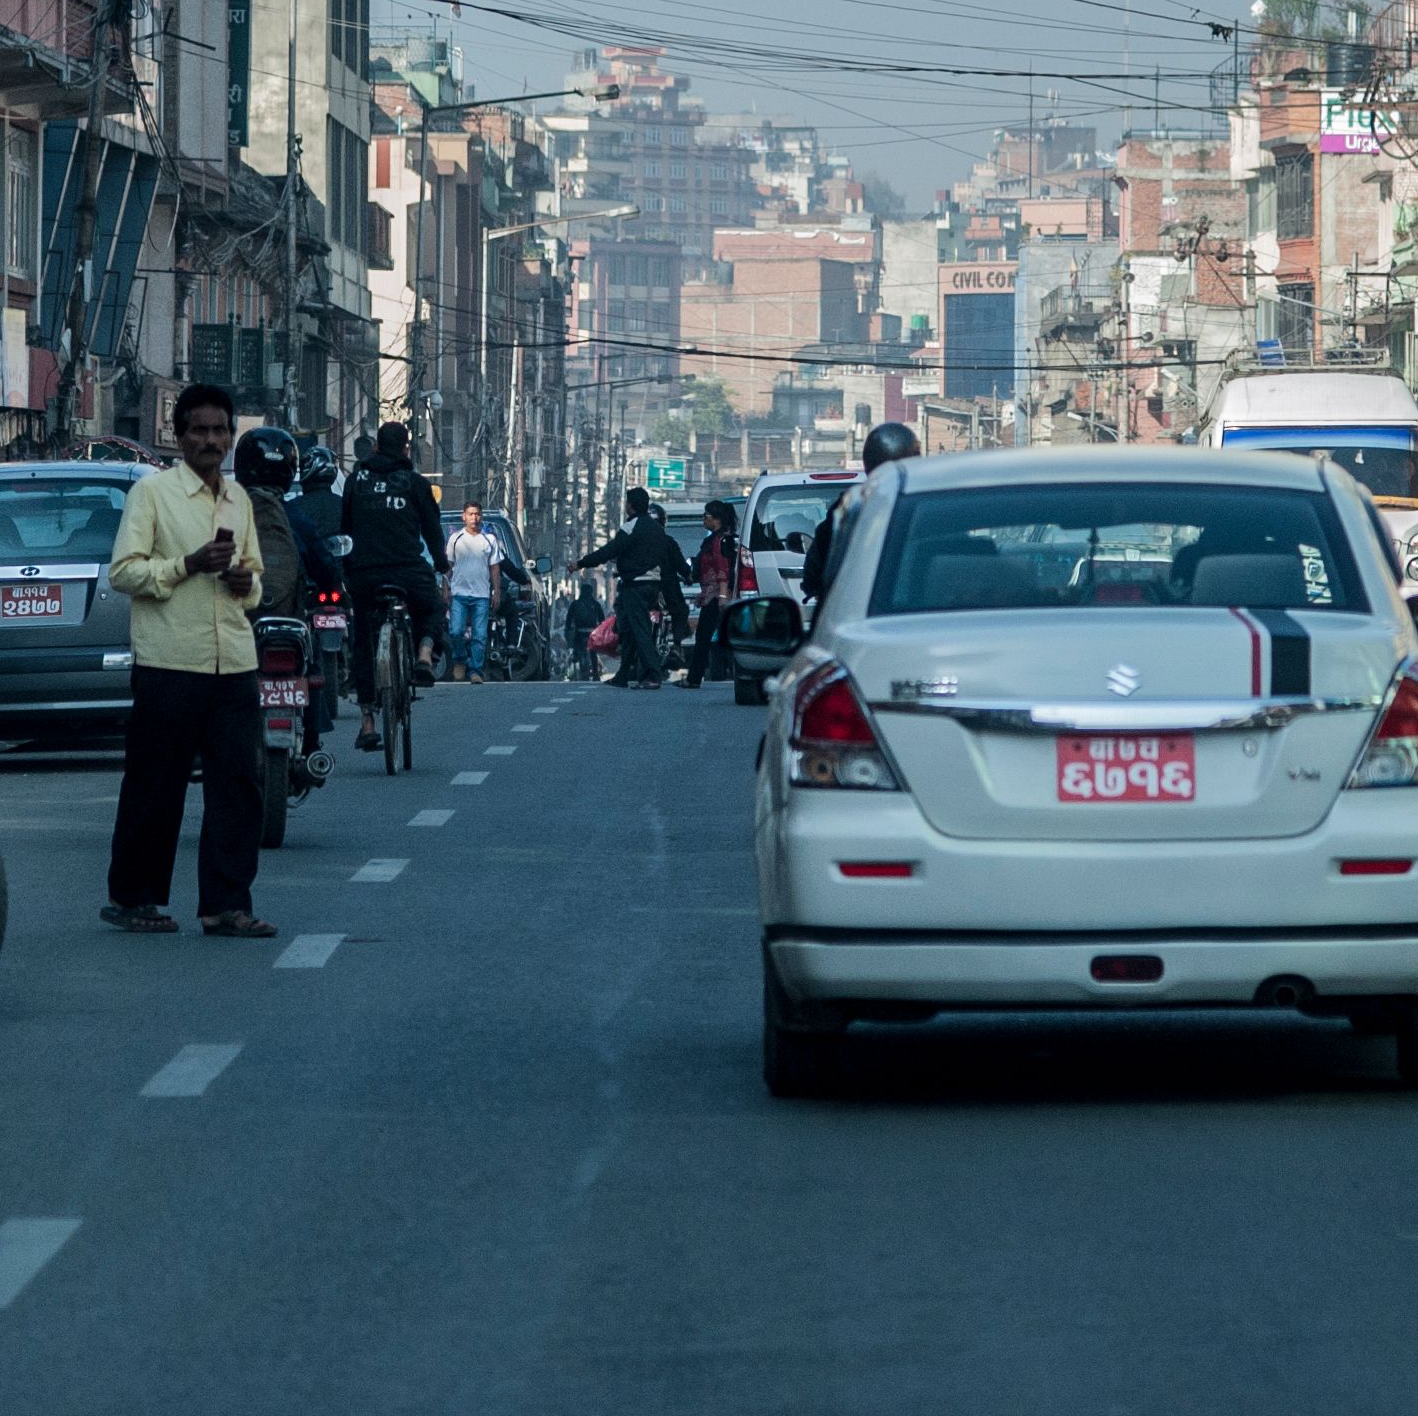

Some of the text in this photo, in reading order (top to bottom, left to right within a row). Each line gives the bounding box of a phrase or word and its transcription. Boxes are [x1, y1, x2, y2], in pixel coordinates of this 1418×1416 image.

[952, 271, 983, 289] CIVIL
[3, 598, 61, 616] २४७७
[1061, 761, 1193, 799] ६७१६
